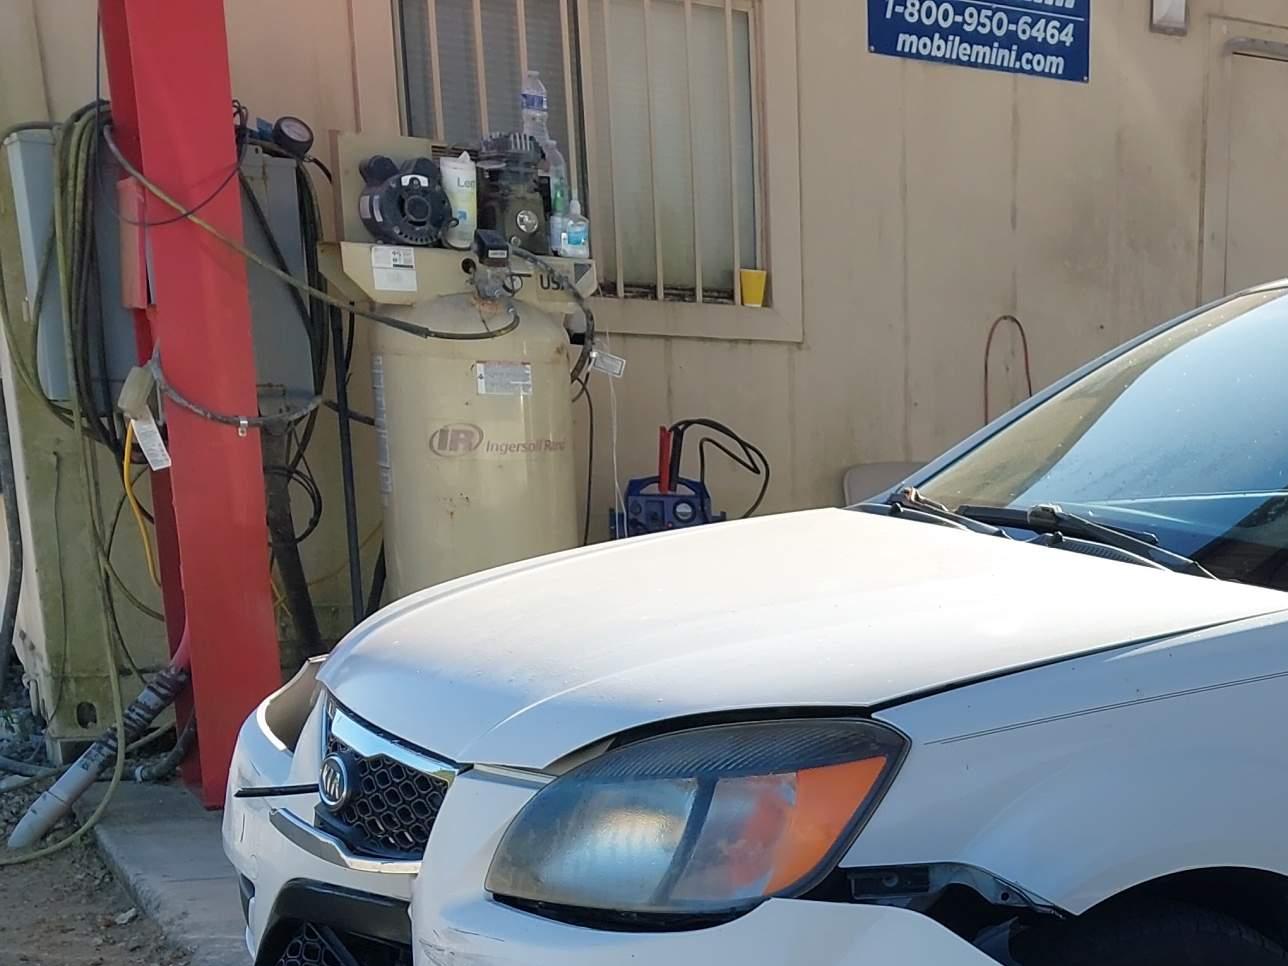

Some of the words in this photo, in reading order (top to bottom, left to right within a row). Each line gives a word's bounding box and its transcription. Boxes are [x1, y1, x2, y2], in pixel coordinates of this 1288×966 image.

[885, 0, 1074, 46] 1-800-950-6464
[896, 32, 1064, 75] mobilemini.com
[540, 273, 565, 290] US
